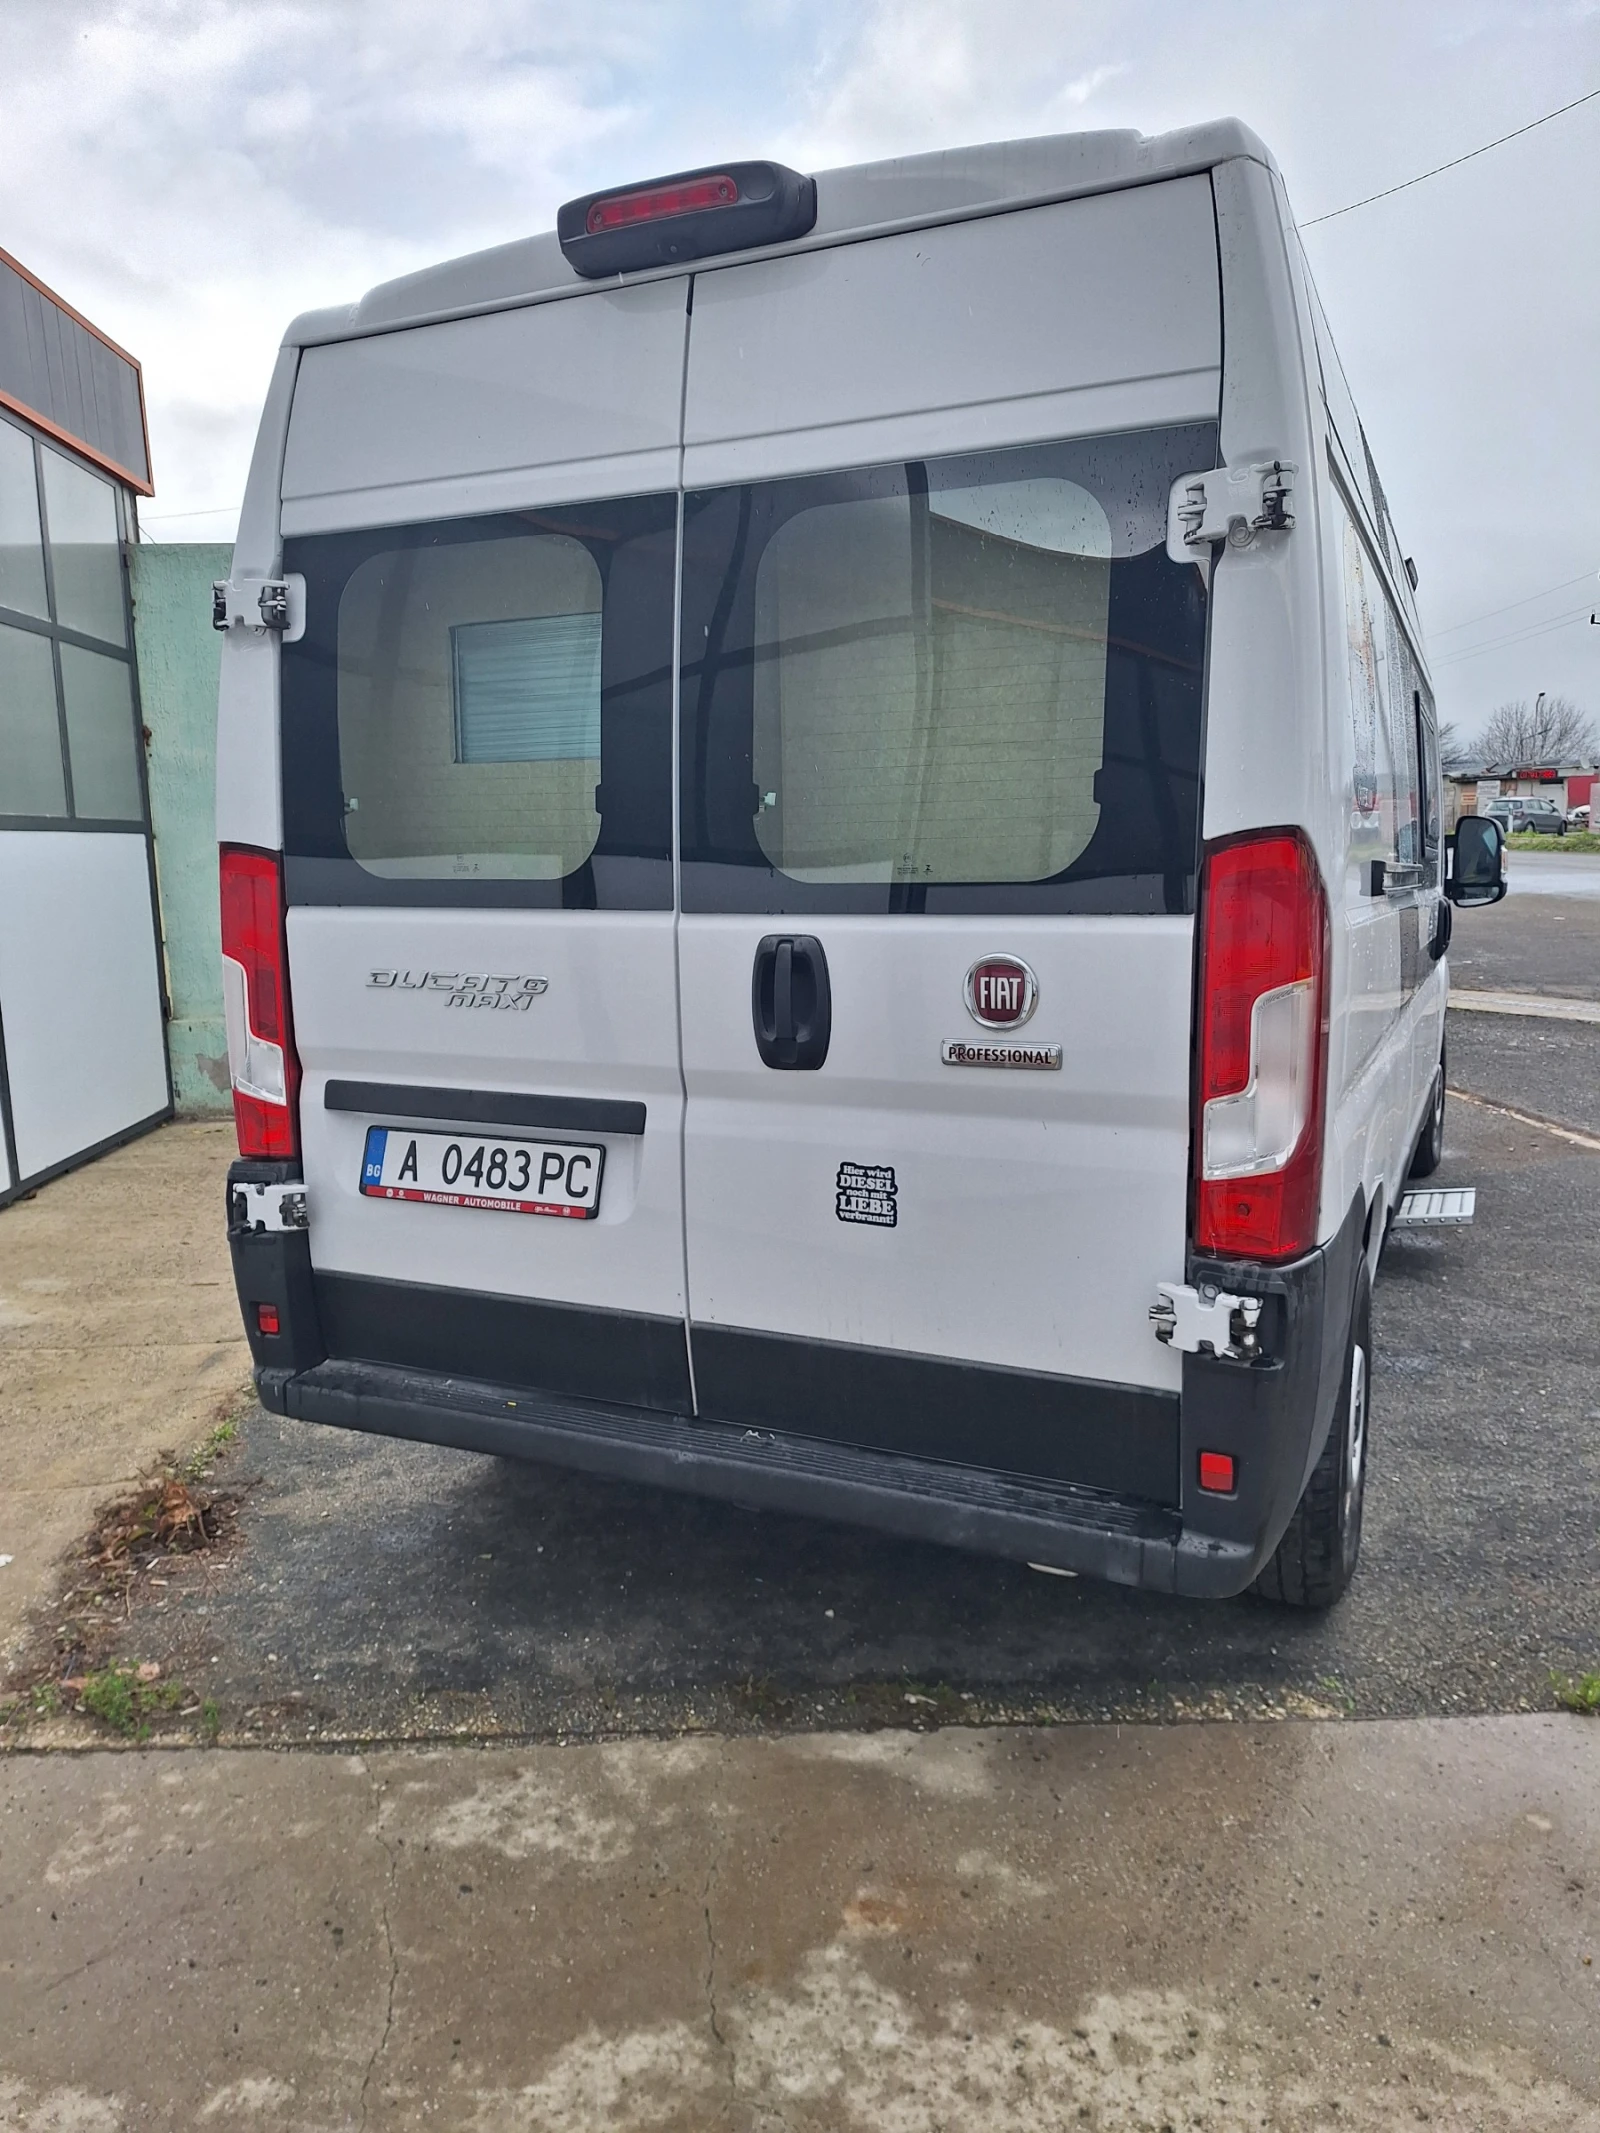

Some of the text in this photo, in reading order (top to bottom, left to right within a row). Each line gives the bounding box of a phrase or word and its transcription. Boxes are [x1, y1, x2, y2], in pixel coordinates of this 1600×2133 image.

[365, 969, 549, 994] DUCATO
[444, 991, 534, 1010] MAXI
[980, 976, 1021, 1010] FIAT
[948, 1046, 1052, 1065] PROFESSIONAL
[366, 1163, 381, 1178] BG
[397, 1140, 592, 1198] A 0483PC
[843, 1165, 892, 1179] Hier wird
[839, 1174, 895, 1192] DIESEL
[423, 1192, 460, 1205] WAGNER
[463, 1197, 521, 1211] AUTOMOBILE
[846, 1189, 888, 1200] noch mit
[839, 1195, 894, 1216] LIEBE
[839, 1210, 894, 1225] verbrannt!
